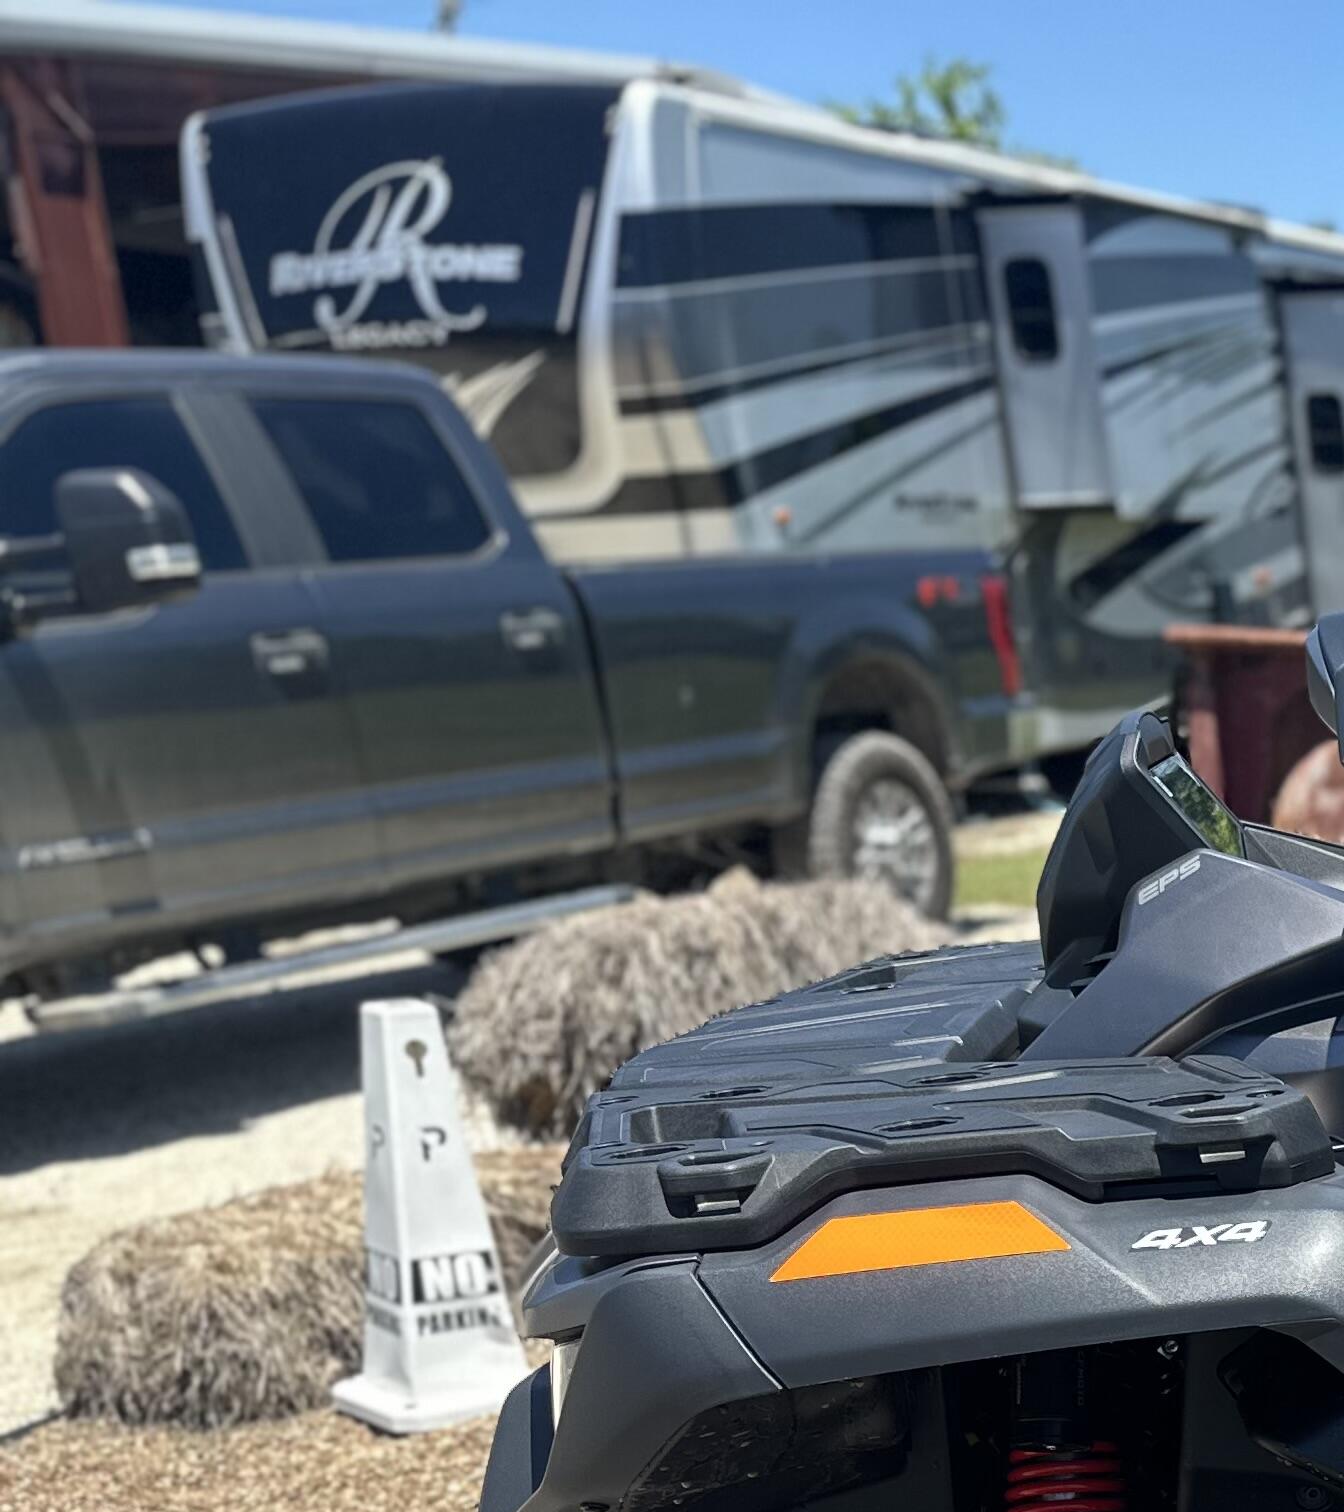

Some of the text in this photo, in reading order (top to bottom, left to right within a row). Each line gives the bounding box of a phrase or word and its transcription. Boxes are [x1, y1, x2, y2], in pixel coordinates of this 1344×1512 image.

[1138, 854, 1201, 906] EPS
[1130, 1220, 1270, 1250] 4X4
[418, 1252, 492, 1302] NO
